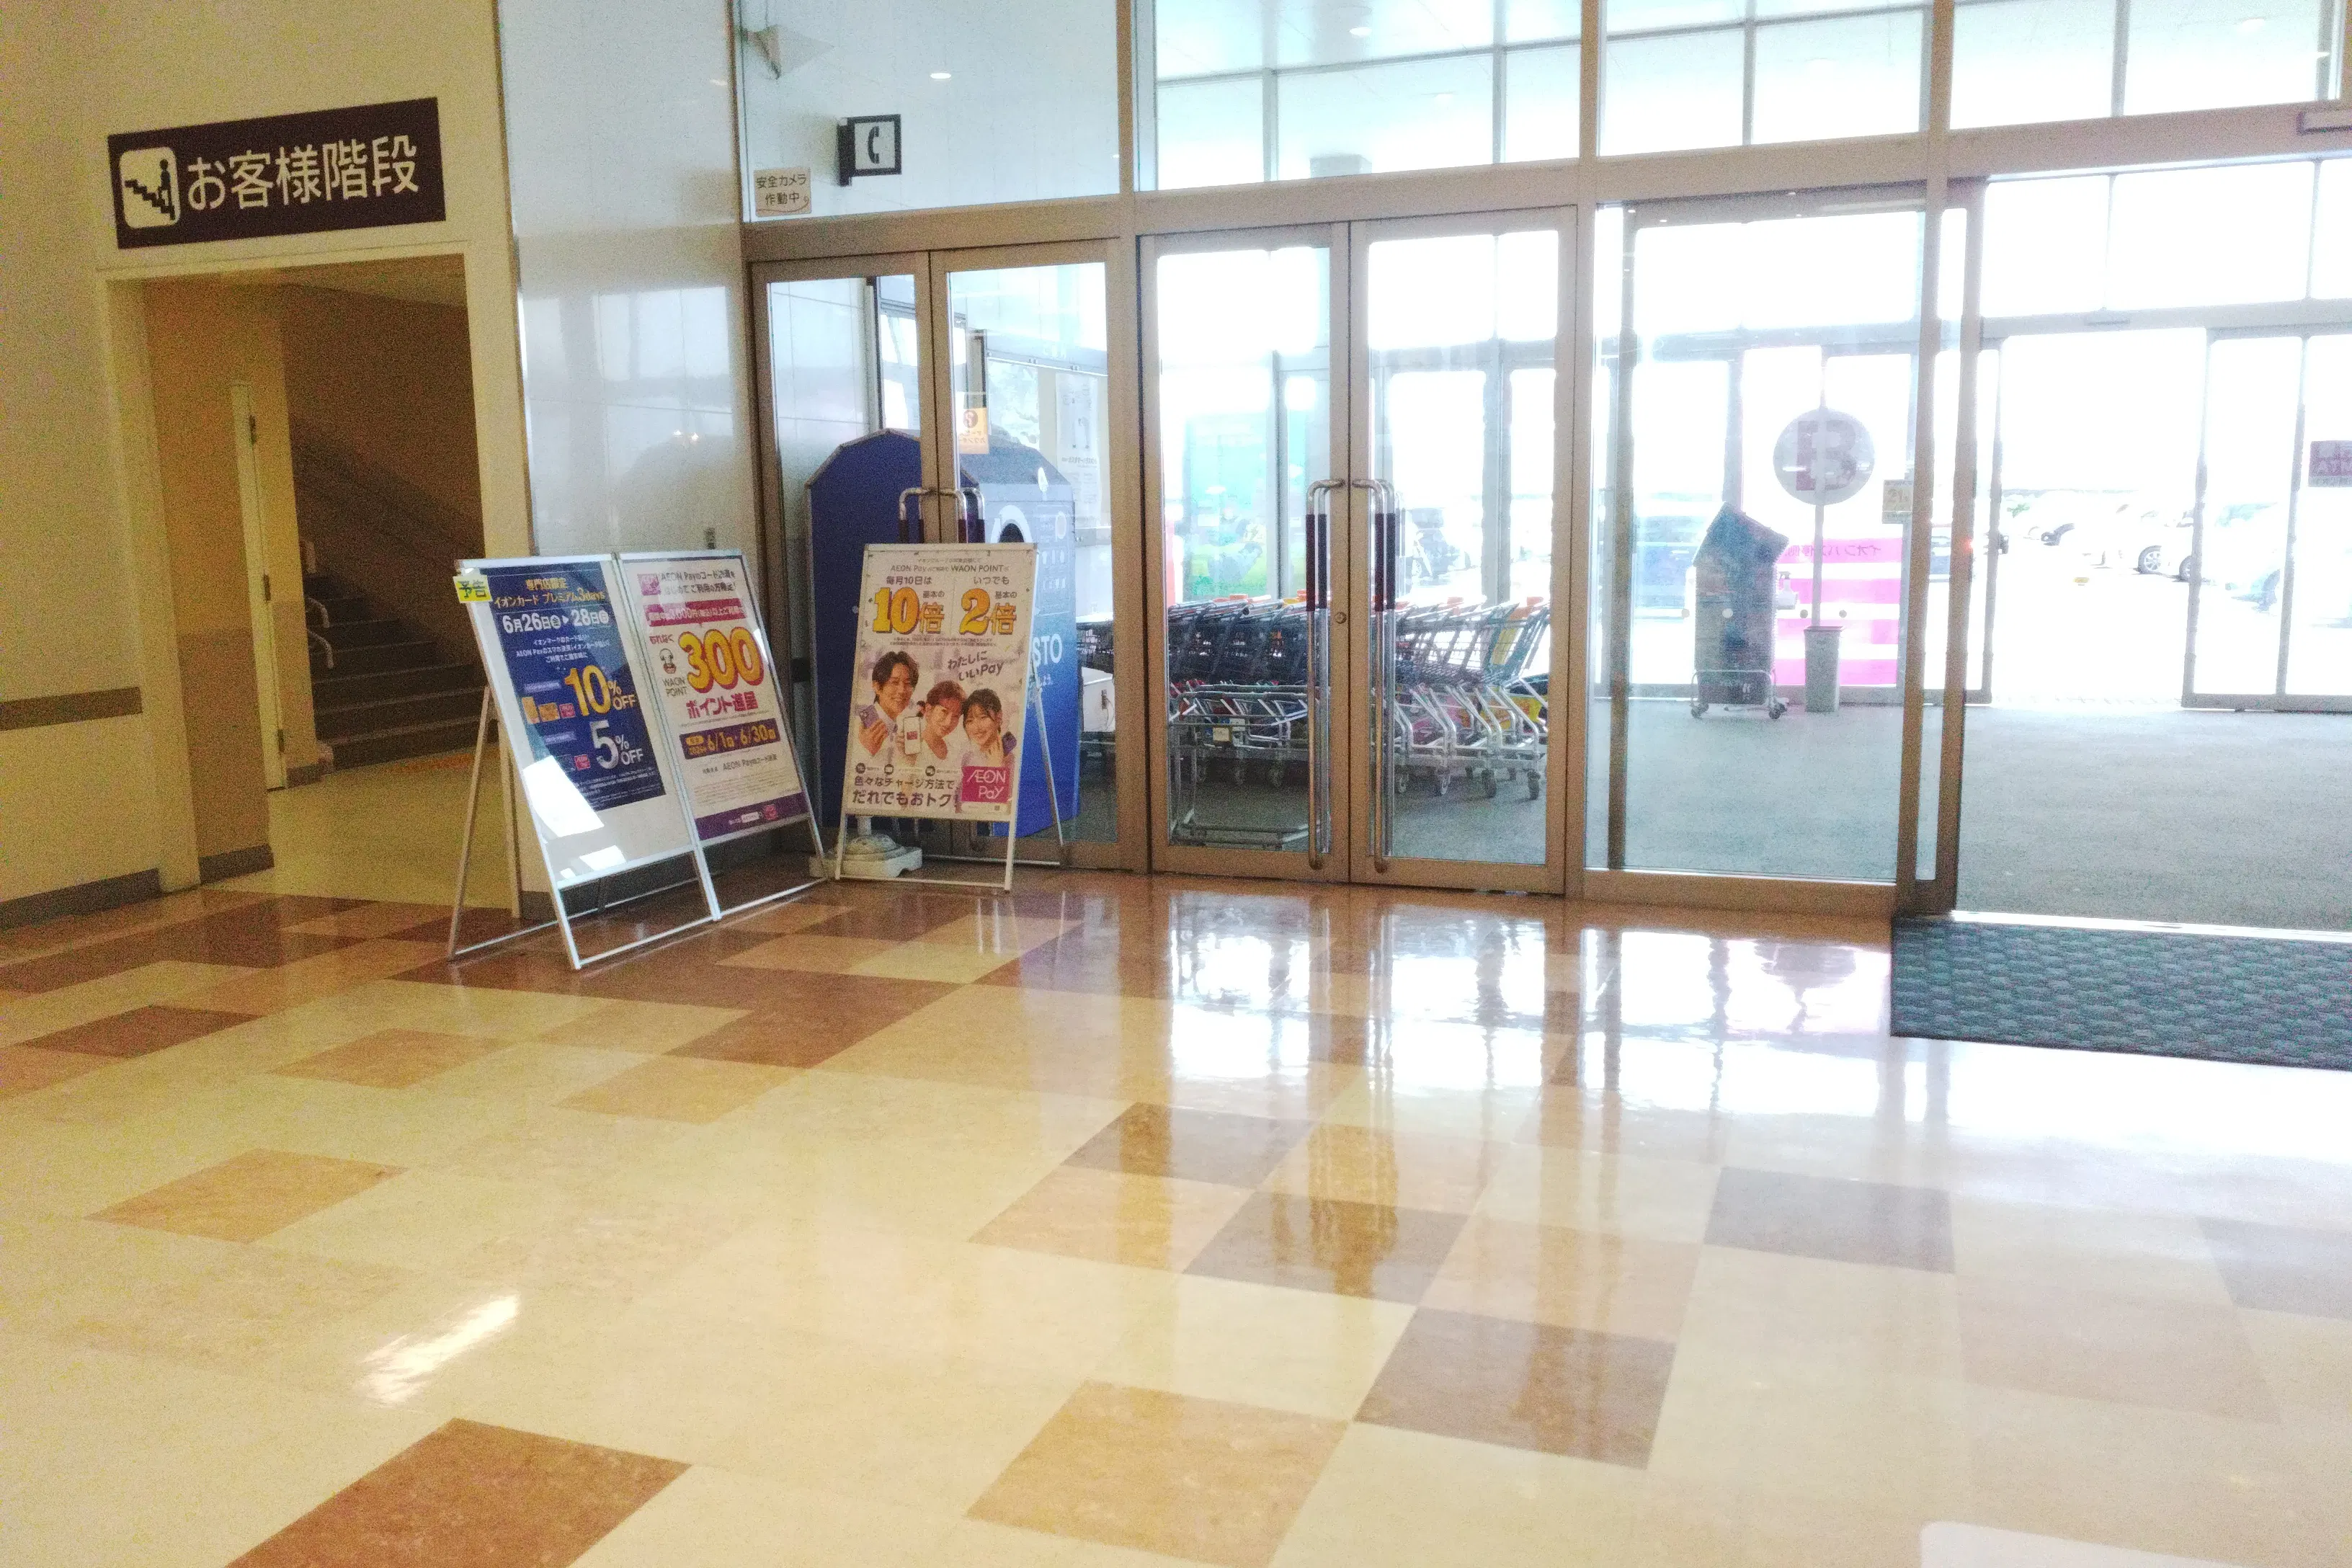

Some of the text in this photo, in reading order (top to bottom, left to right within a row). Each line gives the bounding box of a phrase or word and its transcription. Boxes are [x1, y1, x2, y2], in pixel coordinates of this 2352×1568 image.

[188, 135, 419, 211] お客様階段
[756, 174, 807, 189] 安全カメラ
[765, 192, 800, 207] 作動中
[914, 564, 926, 573] Pay
[950, 564, 977, 573] WAON
[886, 576, 932, 585] 毎月10日は
[974, 576, 1010, 585] いつでも
[458, 579, 489, 600] 予告
[922, 590, 945, 599] 基本の
[994, 590, 1017, 599] 基本の
[494, 595, 539, 610] イオンカード
[678, 626, 765, 694] 300
[947, 651, 988, 672] わたしに
[958, 663, 1004, 682] いいPay
[662, 677, 685, 687] WAON
[665, 686, 688, 698] POINT
[612, 694, 637, 710] OFF
[620, 748, 643, 766] OFF
[978, 785, 1004, 800] Pay
[852, 790, 962, 814] だれでもおトク!
